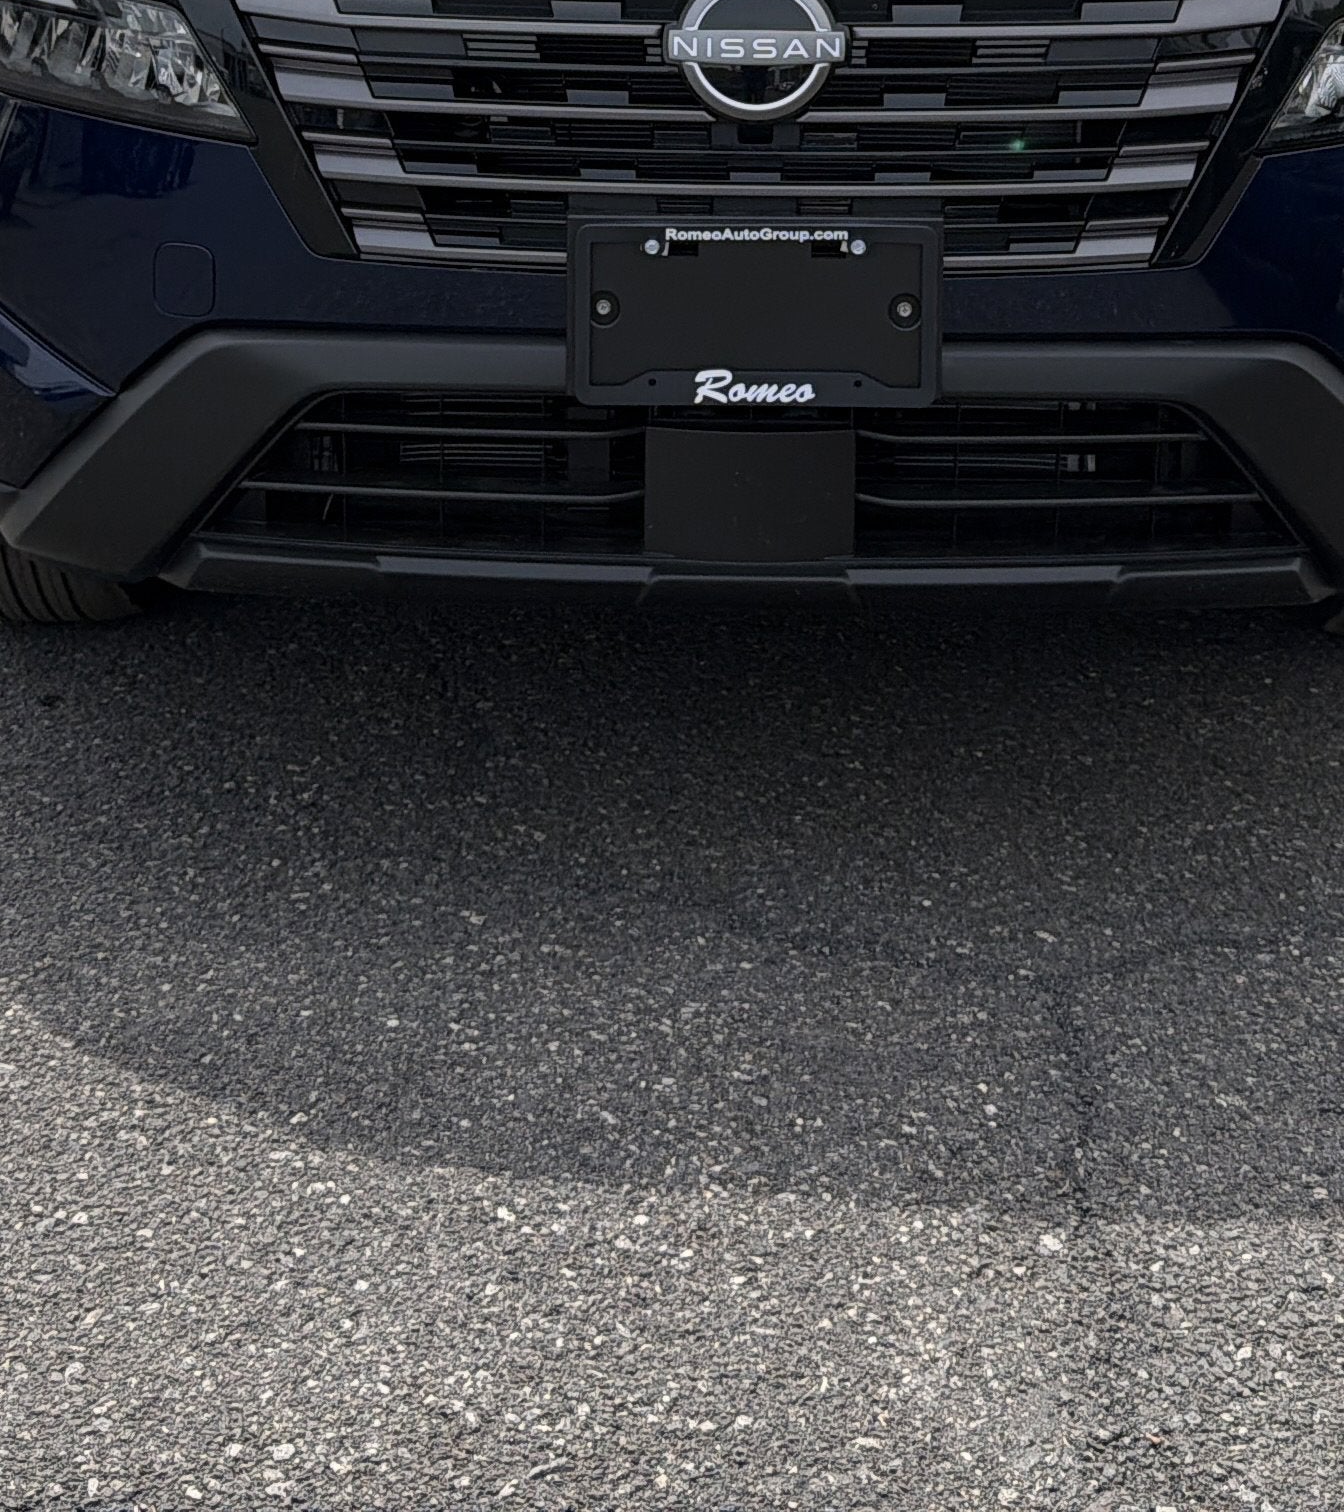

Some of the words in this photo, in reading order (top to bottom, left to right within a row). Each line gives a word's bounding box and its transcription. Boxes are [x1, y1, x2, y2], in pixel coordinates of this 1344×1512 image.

[673, 36, 841, 59] NISSAN
[665, 227, 849, 243] RomeoAutoGroup.com
[694, 369, 816, 404] Romeo
